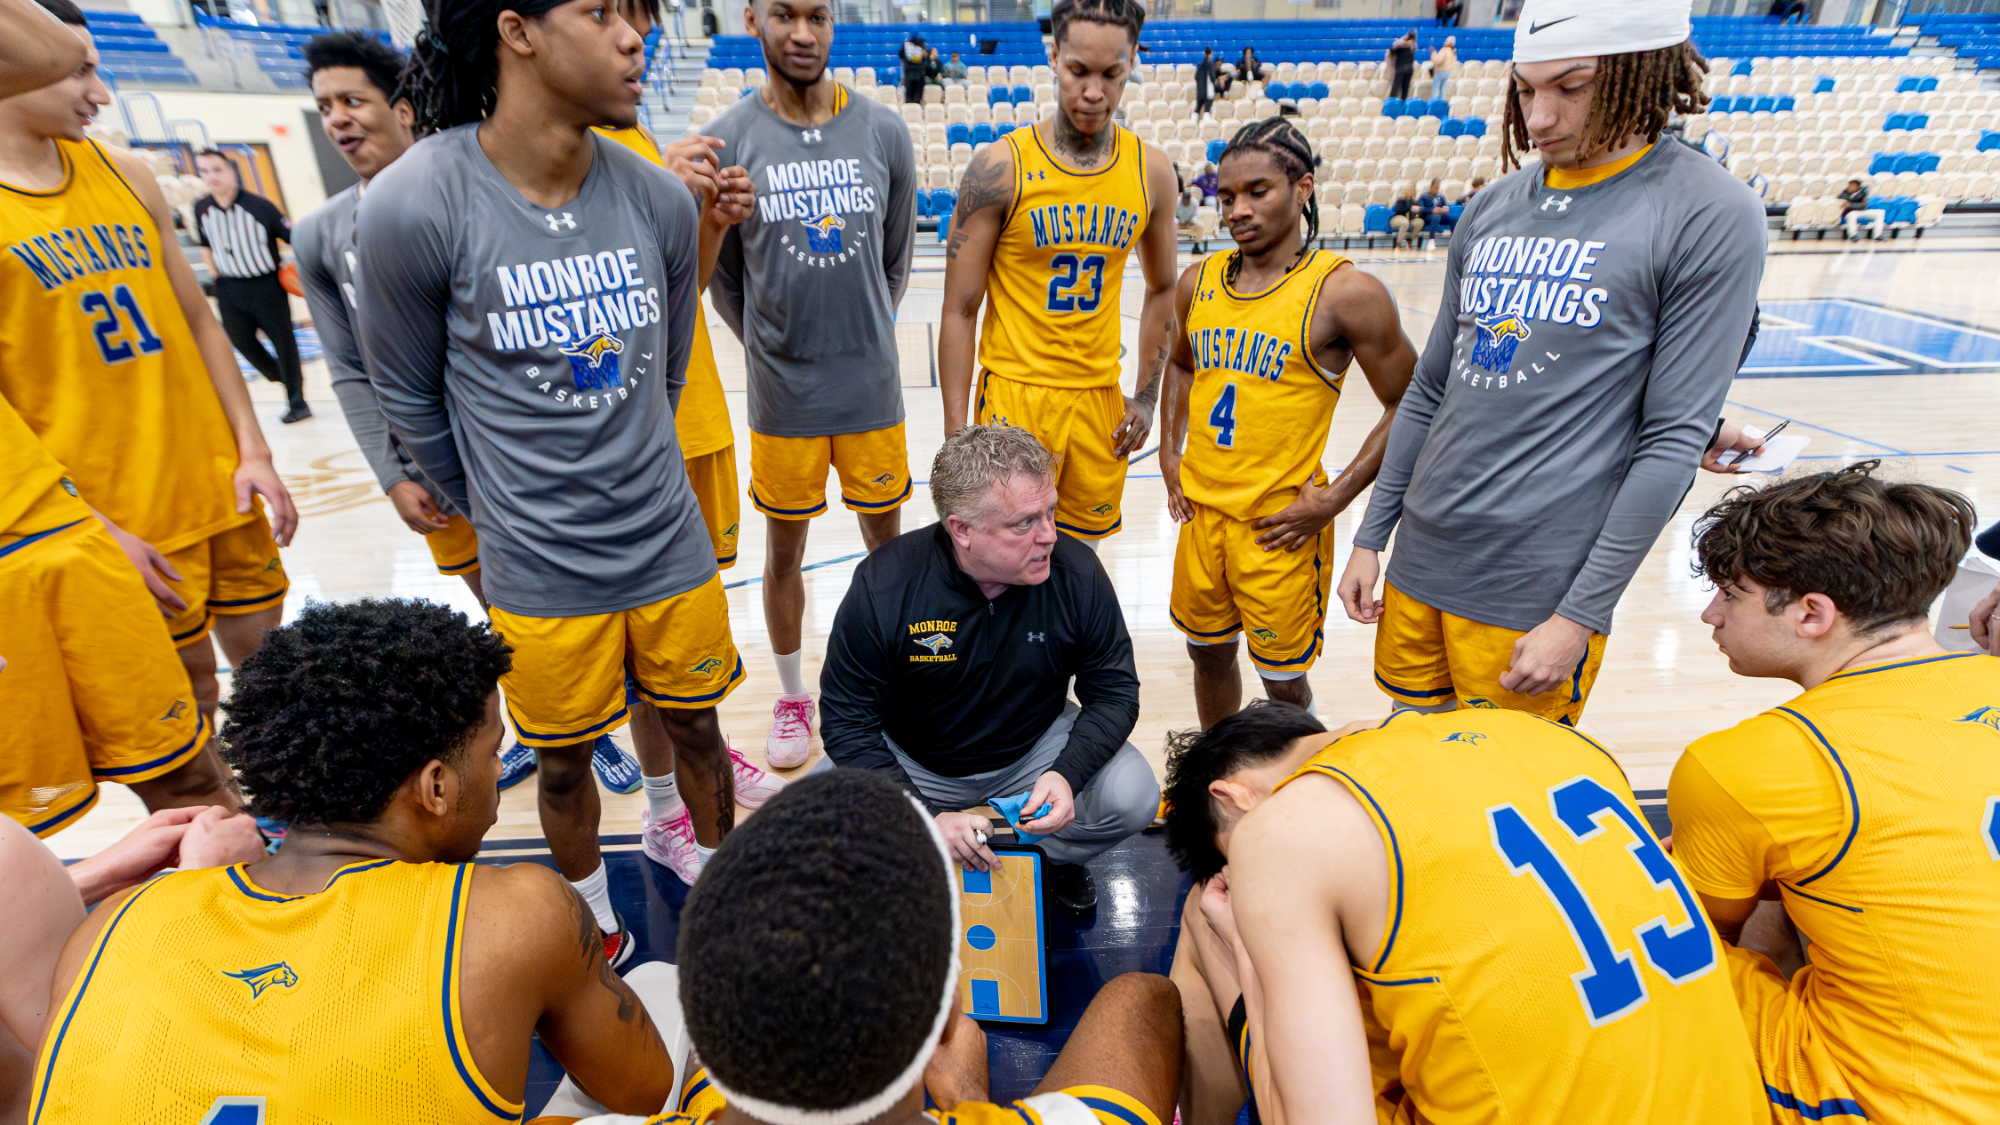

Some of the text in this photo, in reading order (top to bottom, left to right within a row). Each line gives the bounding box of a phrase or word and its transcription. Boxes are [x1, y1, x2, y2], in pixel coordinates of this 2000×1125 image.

[765, 158, 864, 192] MONROE
[758, 186, 876, 224] MUSTANGS
[1030, 203, 1139, 249] MUSTANGS
[8, 223, 152, 291] MUSTANGS
[497, 247, 646, 308] MONROE
[781, 230, 866, 268] BASKETBALL
[1467, 236, 1607, 283] MONROE
[1046, 252, 1107, 313] 23
[78, 282, 165, 366] 21
[487, 287, 661, 351] MUSTANGS
[525, 352, 653, 409] BASKETBALL
[1190, 326, 1293, 382] MUSTANGS
[1456, 333, 1561, 390] BASKETBALL
[1208, 381, 1238, 448] 4
[908, 620, 958, 635] MONROE
[909, 653, 958, 662] BASKETBALL
[1484, 773, 1718, 1029] 13
